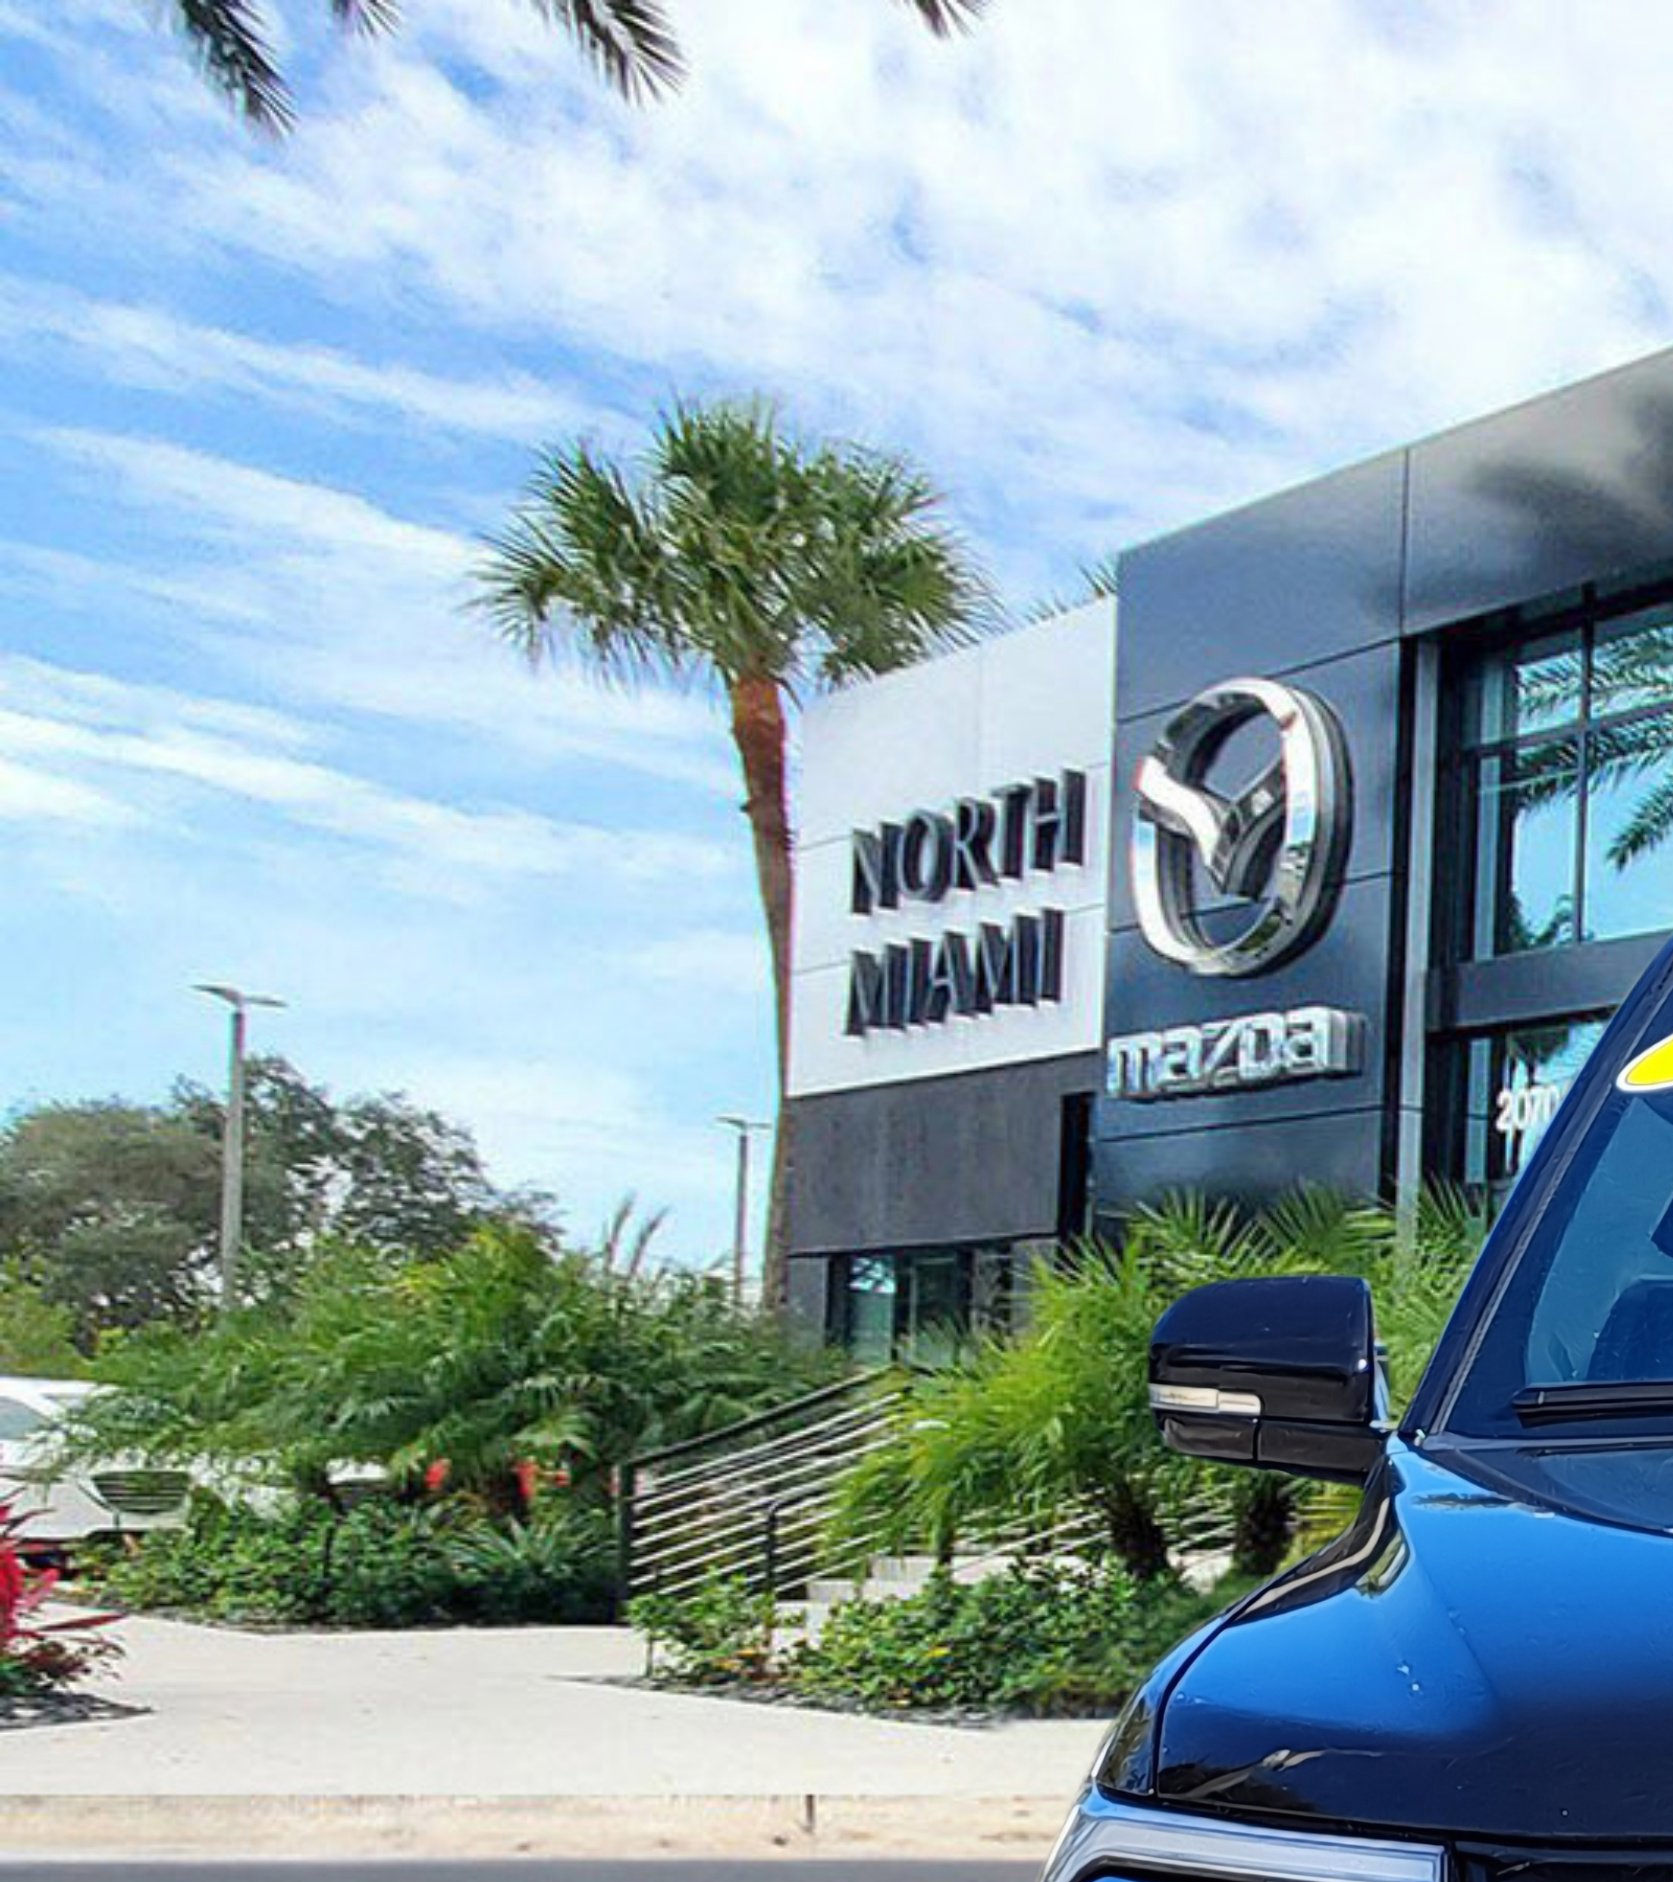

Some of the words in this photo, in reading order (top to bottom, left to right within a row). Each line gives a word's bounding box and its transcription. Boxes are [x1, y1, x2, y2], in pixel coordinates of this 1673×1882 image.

[851, 768, 1087, 916] NORTH
[846, 906, 1065, 1036] MIAMI
[1107, 1006, 1364, 1098] mazda
